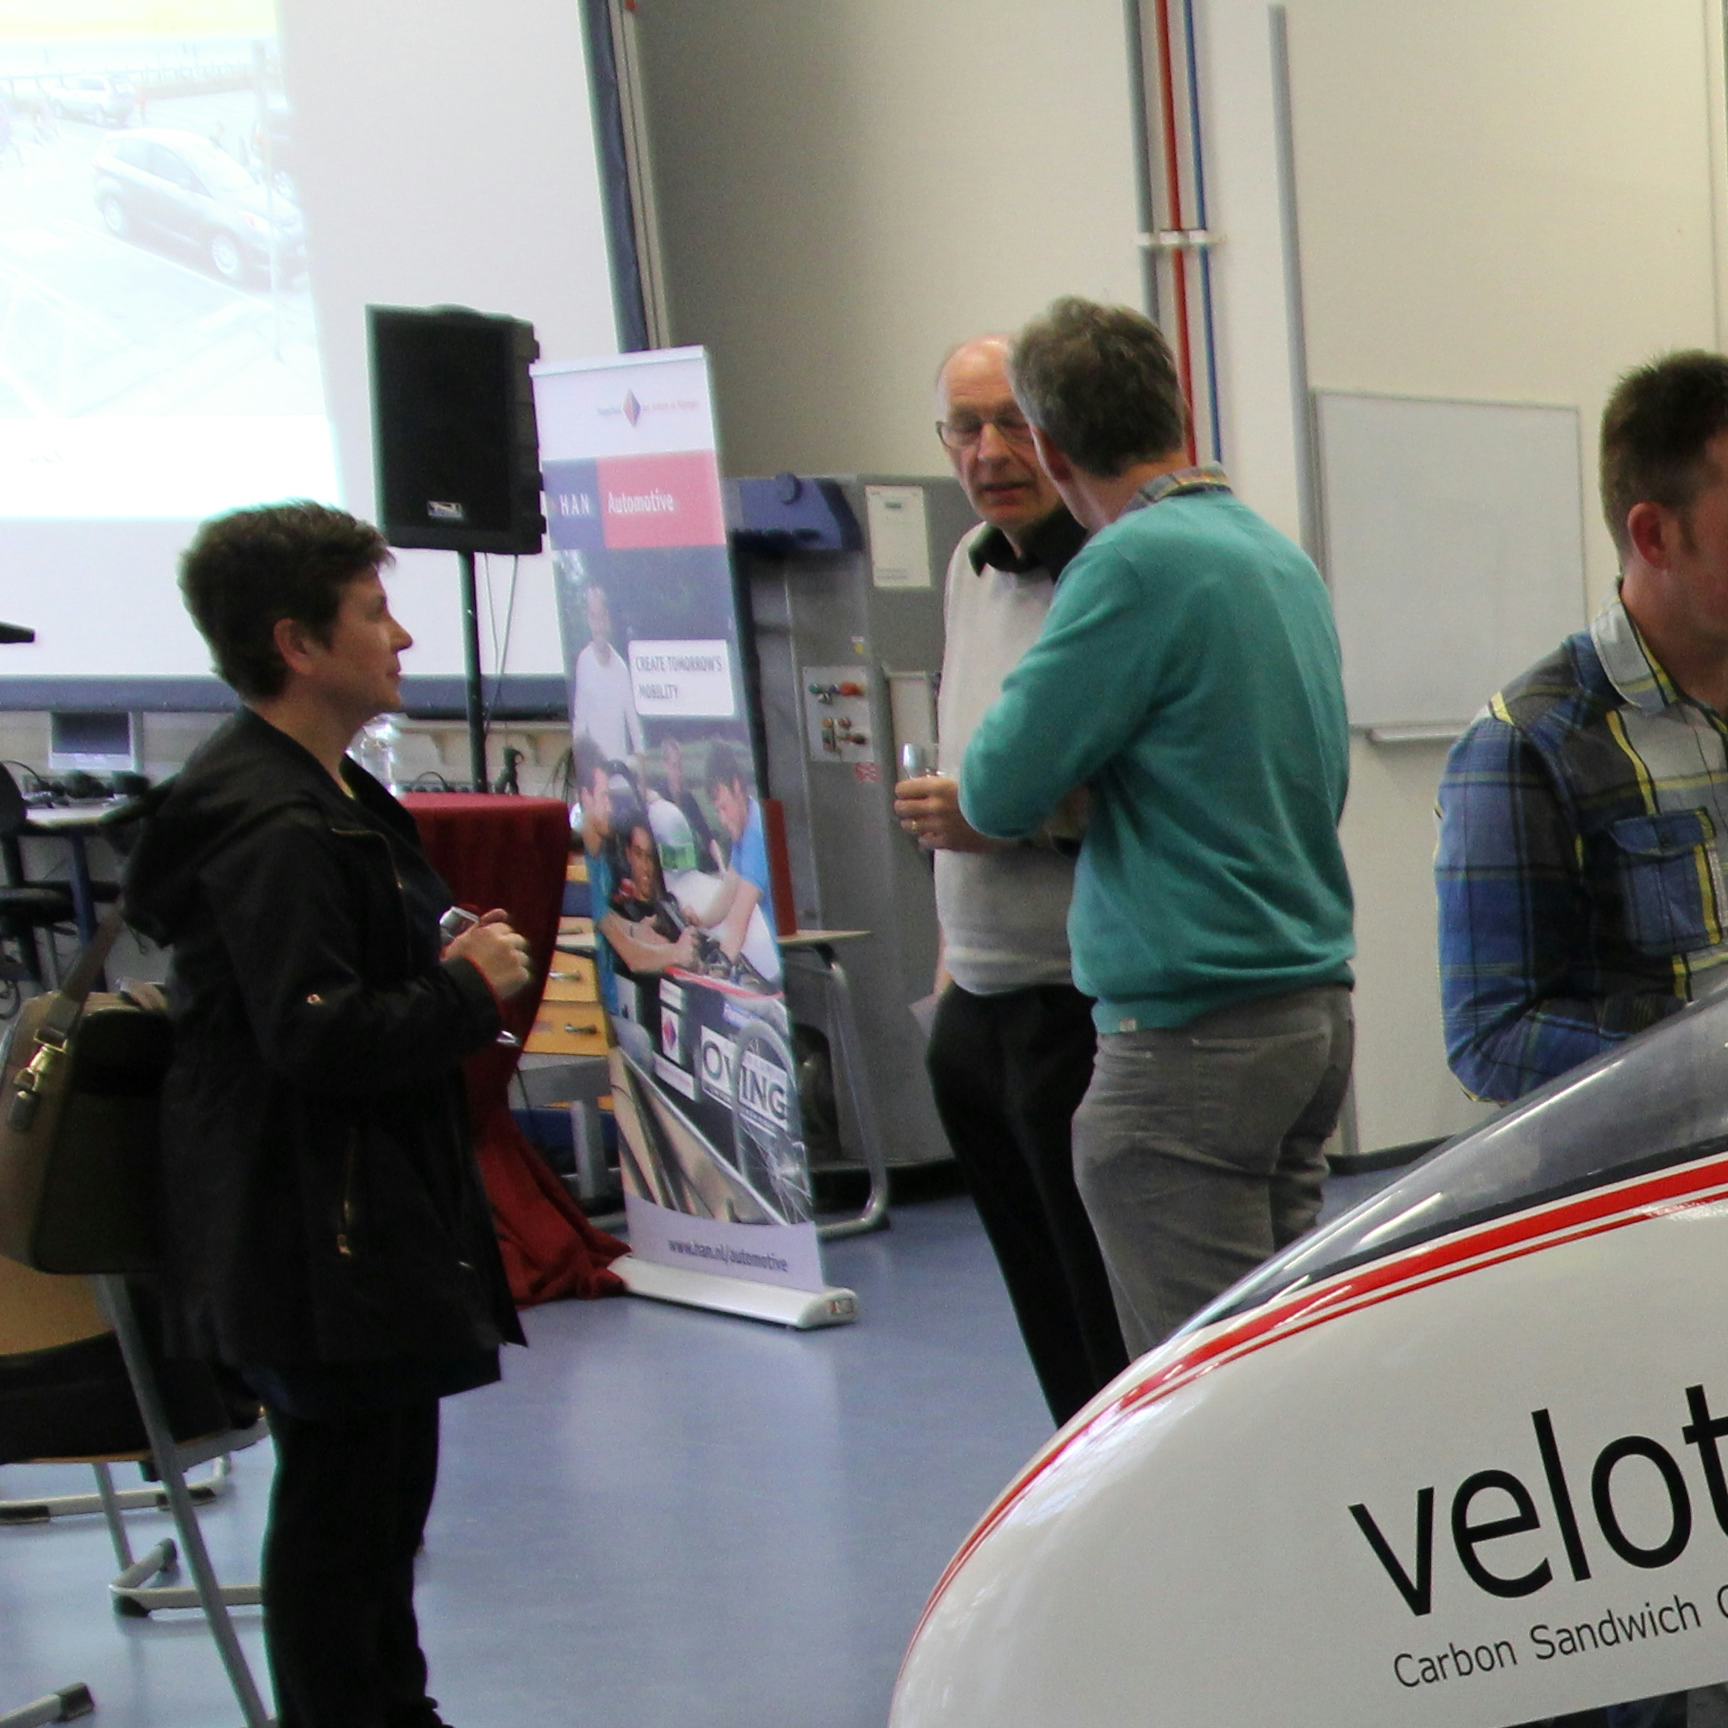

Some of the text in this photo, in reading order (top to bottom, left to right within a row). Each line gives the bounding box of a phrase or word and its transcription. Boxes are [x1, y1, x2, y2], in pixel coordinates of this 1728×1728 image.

[560, 488, 675, 516] HAN Automotive
[635, 655, 723, 672] CREATE TOMORROW'S
[638, 684, 680, 700] MOBILITY
[1393, 1633, 1518, 1689] Carbon
[1529, 1594, 1702, 1661] Sandwich
